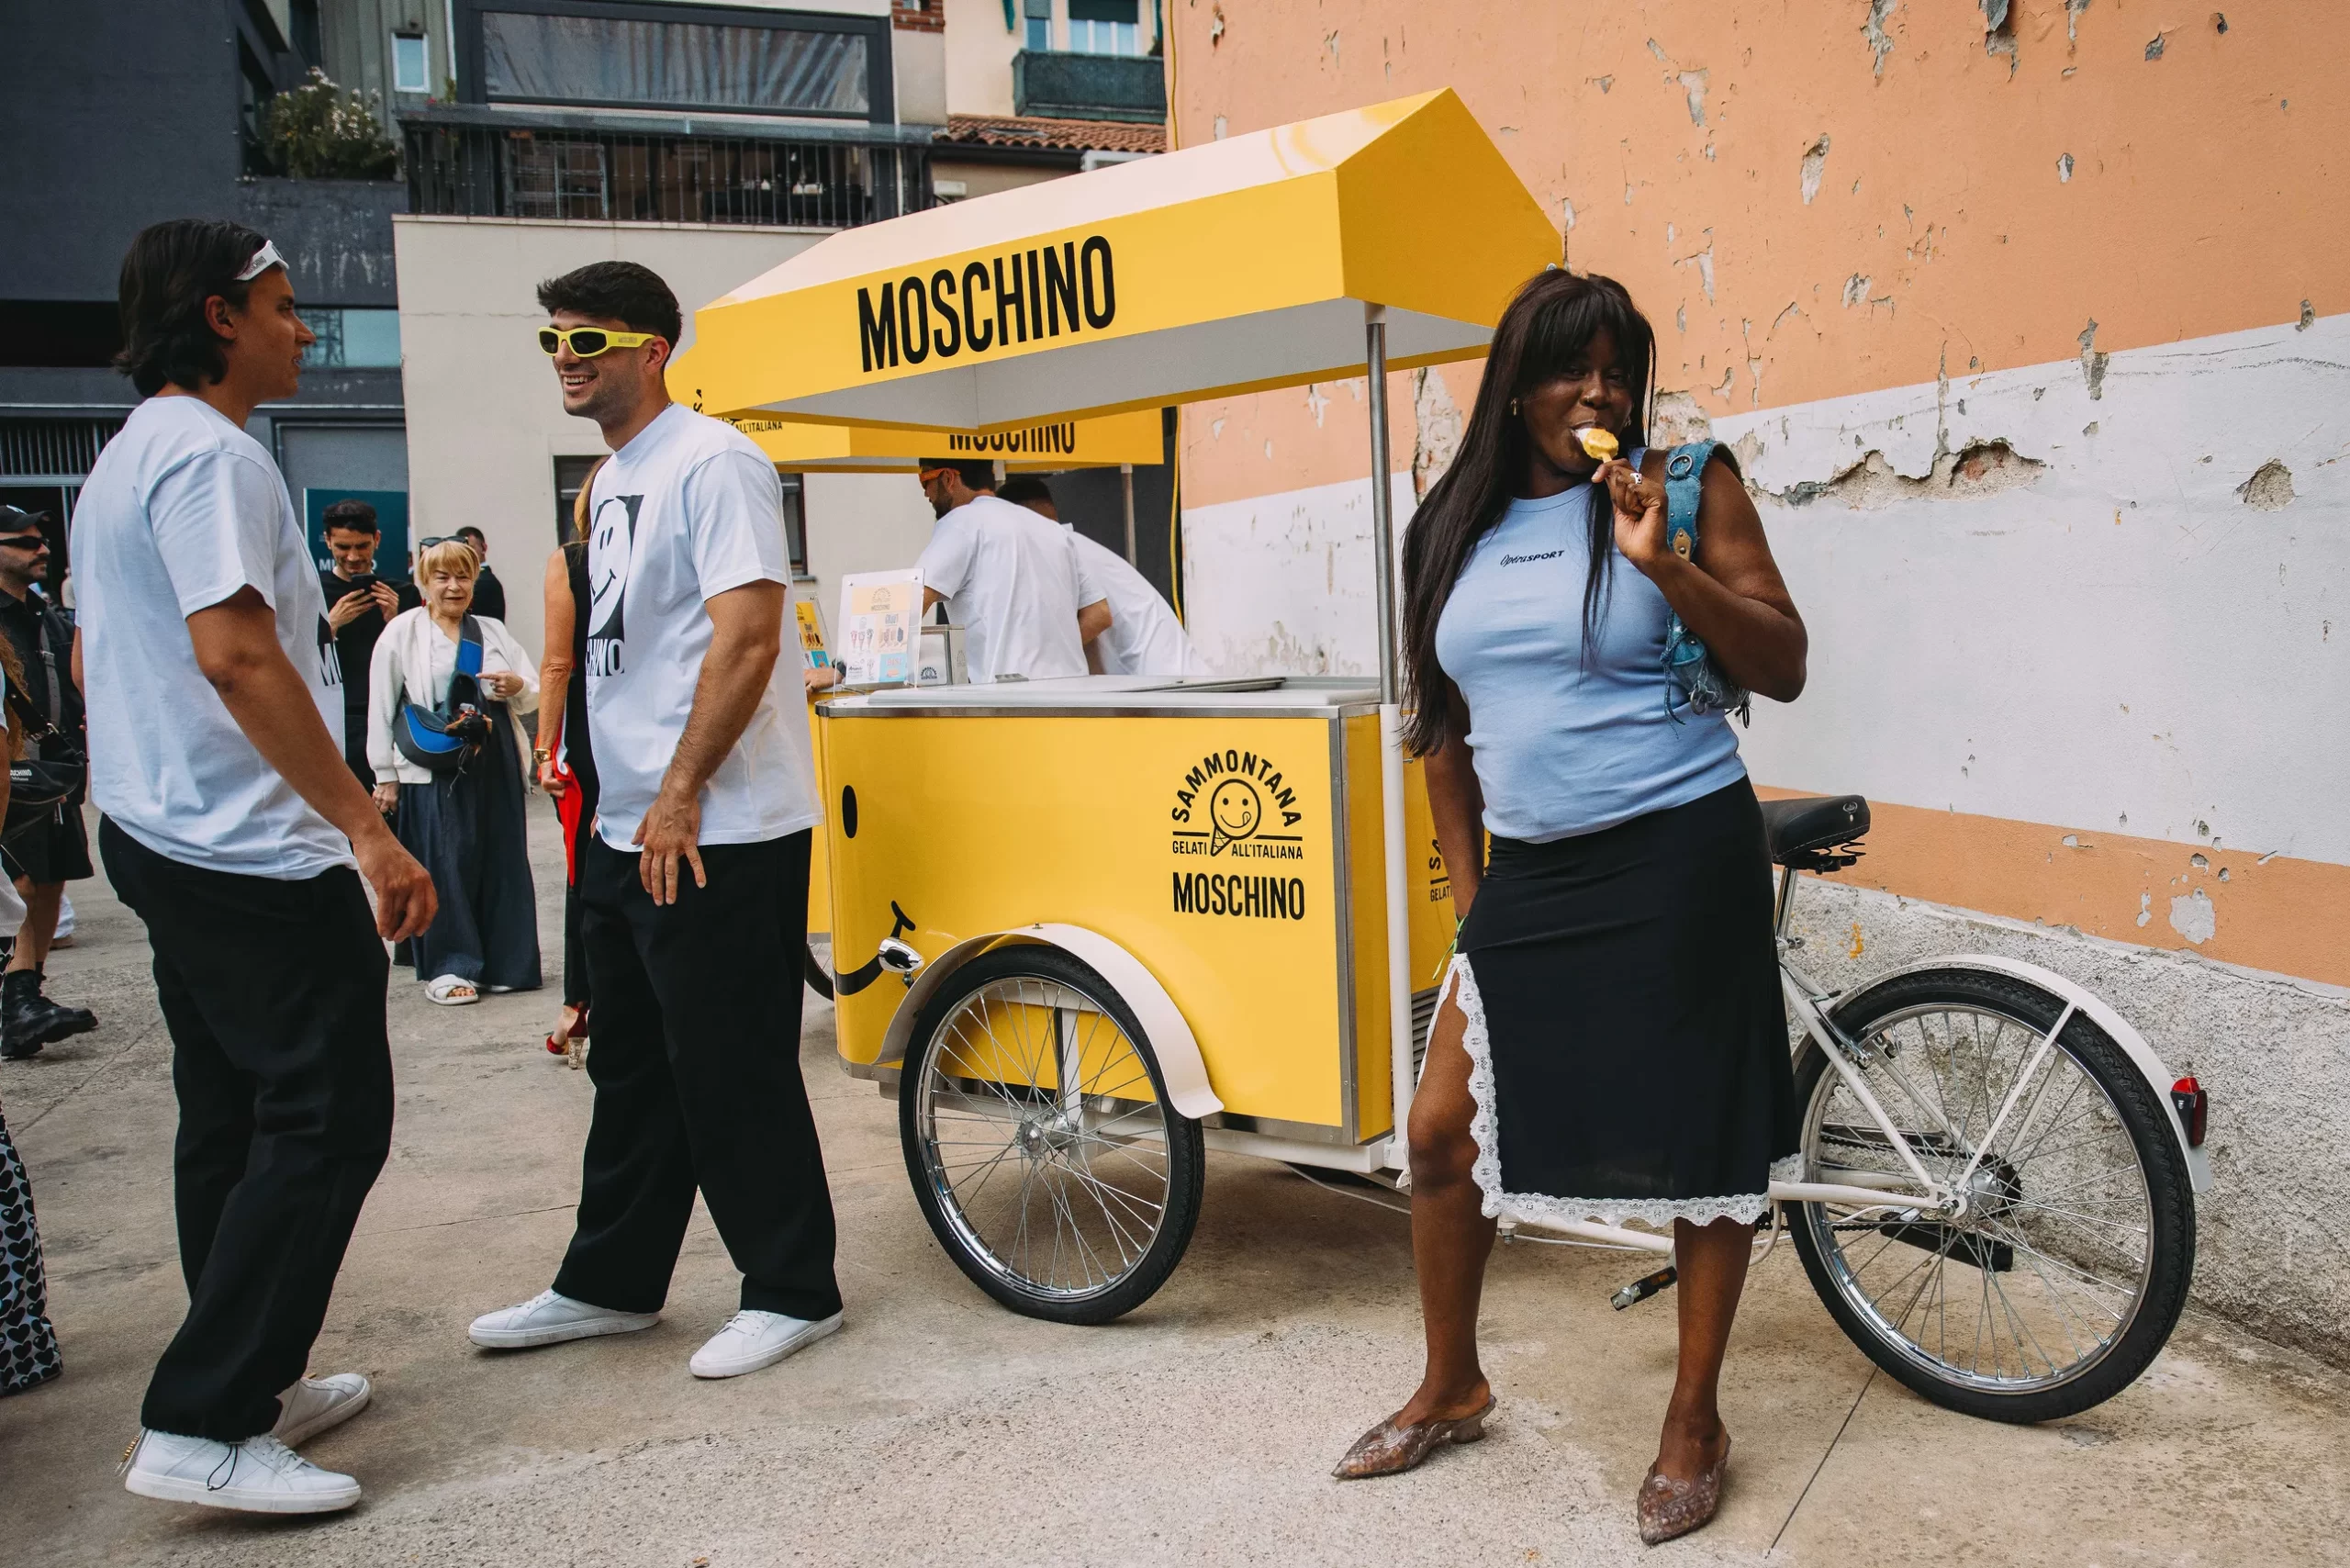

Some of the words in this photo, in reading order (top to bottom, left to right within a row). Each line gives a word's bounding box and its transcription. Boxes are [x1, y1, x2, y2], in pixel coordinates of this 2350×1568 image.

[856, 235, 1116, 373] MOSCHINO
[1171, 749, 1303, 828] SAMMONTANA
[1172, 840, 1207, 857] GELATI
[1231, 843, 1304, 860] ALL'ITALIANA
[1172, 871, 1305, 921] MOSCHINO
